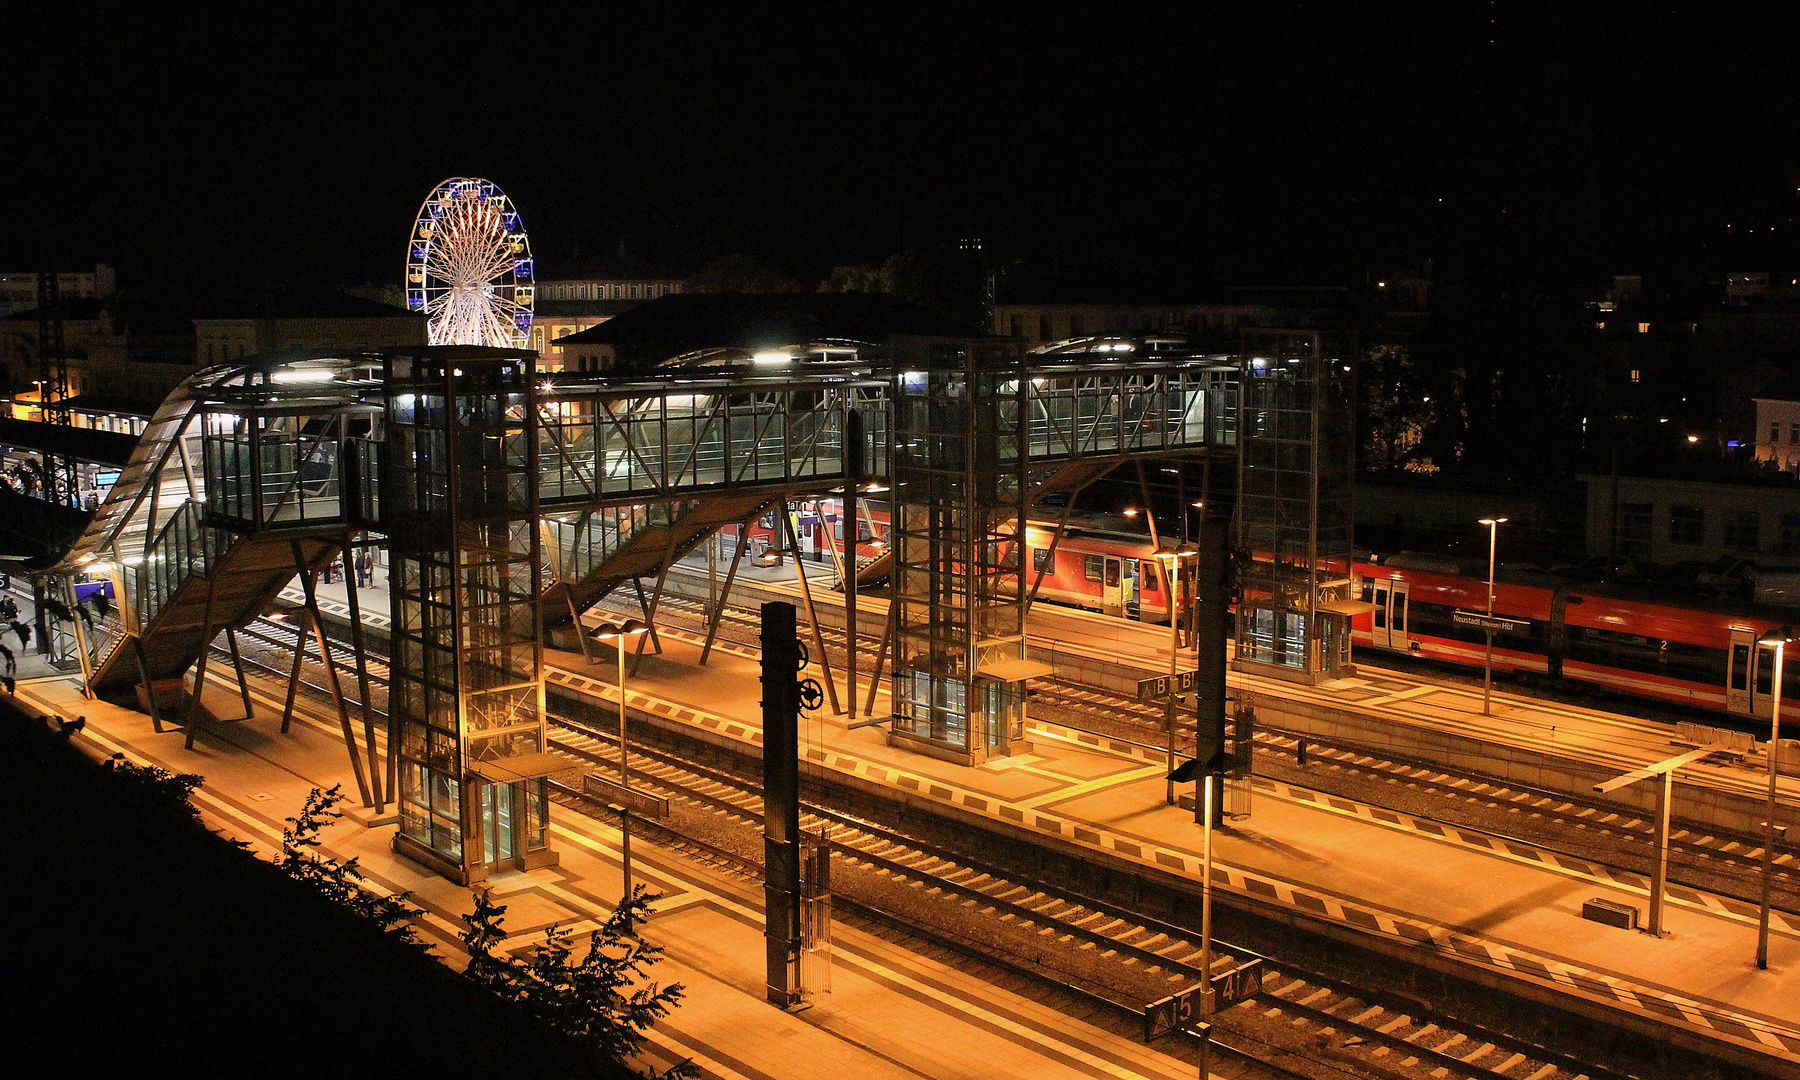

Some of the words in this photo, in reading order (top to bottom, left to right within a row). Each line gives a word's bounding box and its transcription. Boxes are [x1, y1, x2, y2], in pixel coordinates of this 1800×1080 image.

[1453, 614, 1481, 626] Neustadt
[1660, 639, 1668, 650] 2
[1157, 678, 1166, 694] B
[1182, 673, 1191, 689] B
[1222, 974, 1235, 1000] 4
[1179, 993, 1192, 1021] 5
